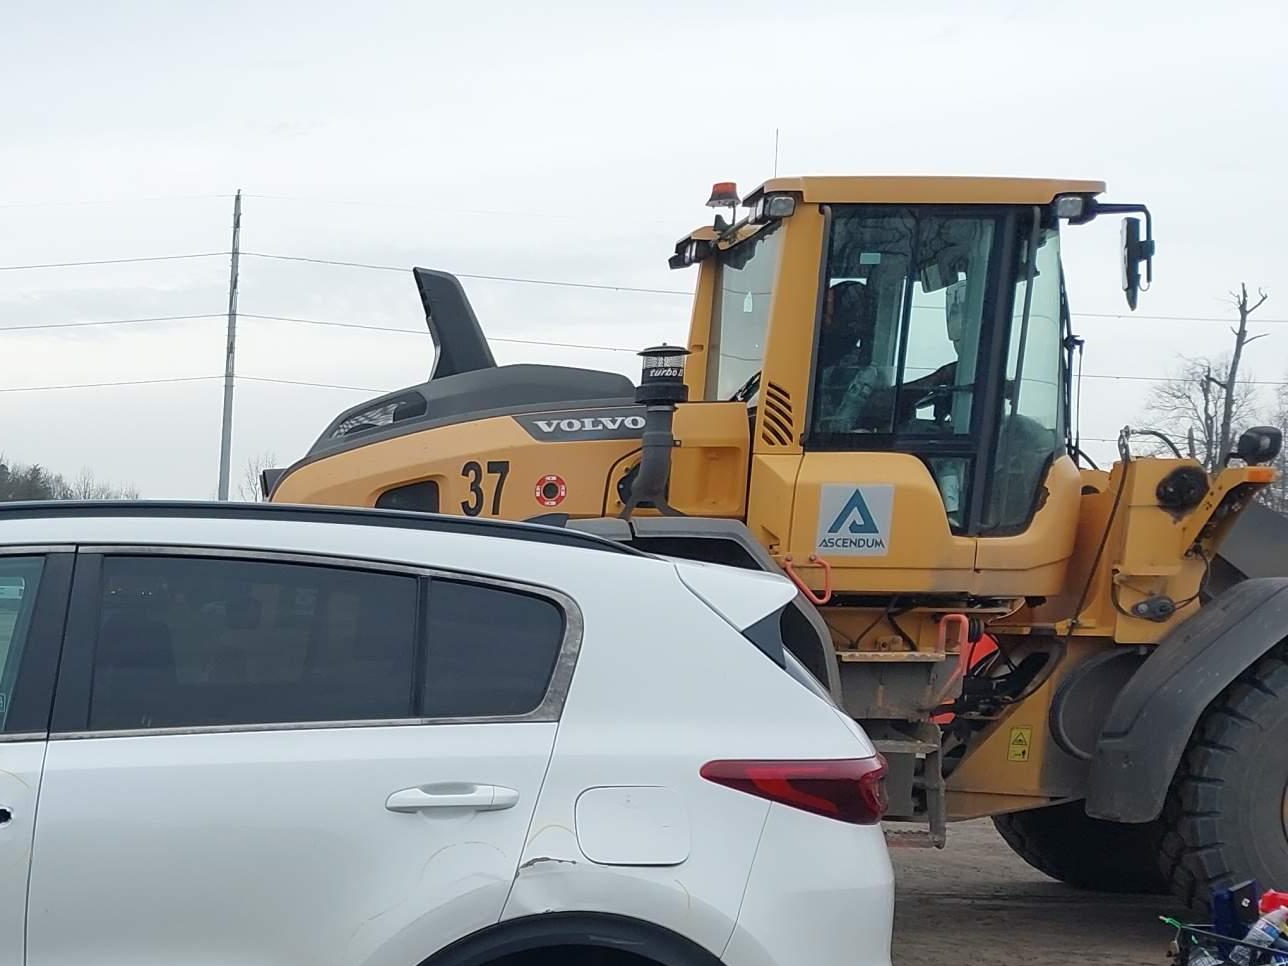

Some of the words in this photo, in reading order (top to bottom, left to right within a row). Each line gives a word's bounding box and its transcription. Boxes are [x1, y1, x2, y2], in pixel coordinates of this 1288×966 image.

[532, 416, 647, 433] VOLVO
[461, 460, 510, 517] 37
[818, 537, 886, 549] ASCENDUM
